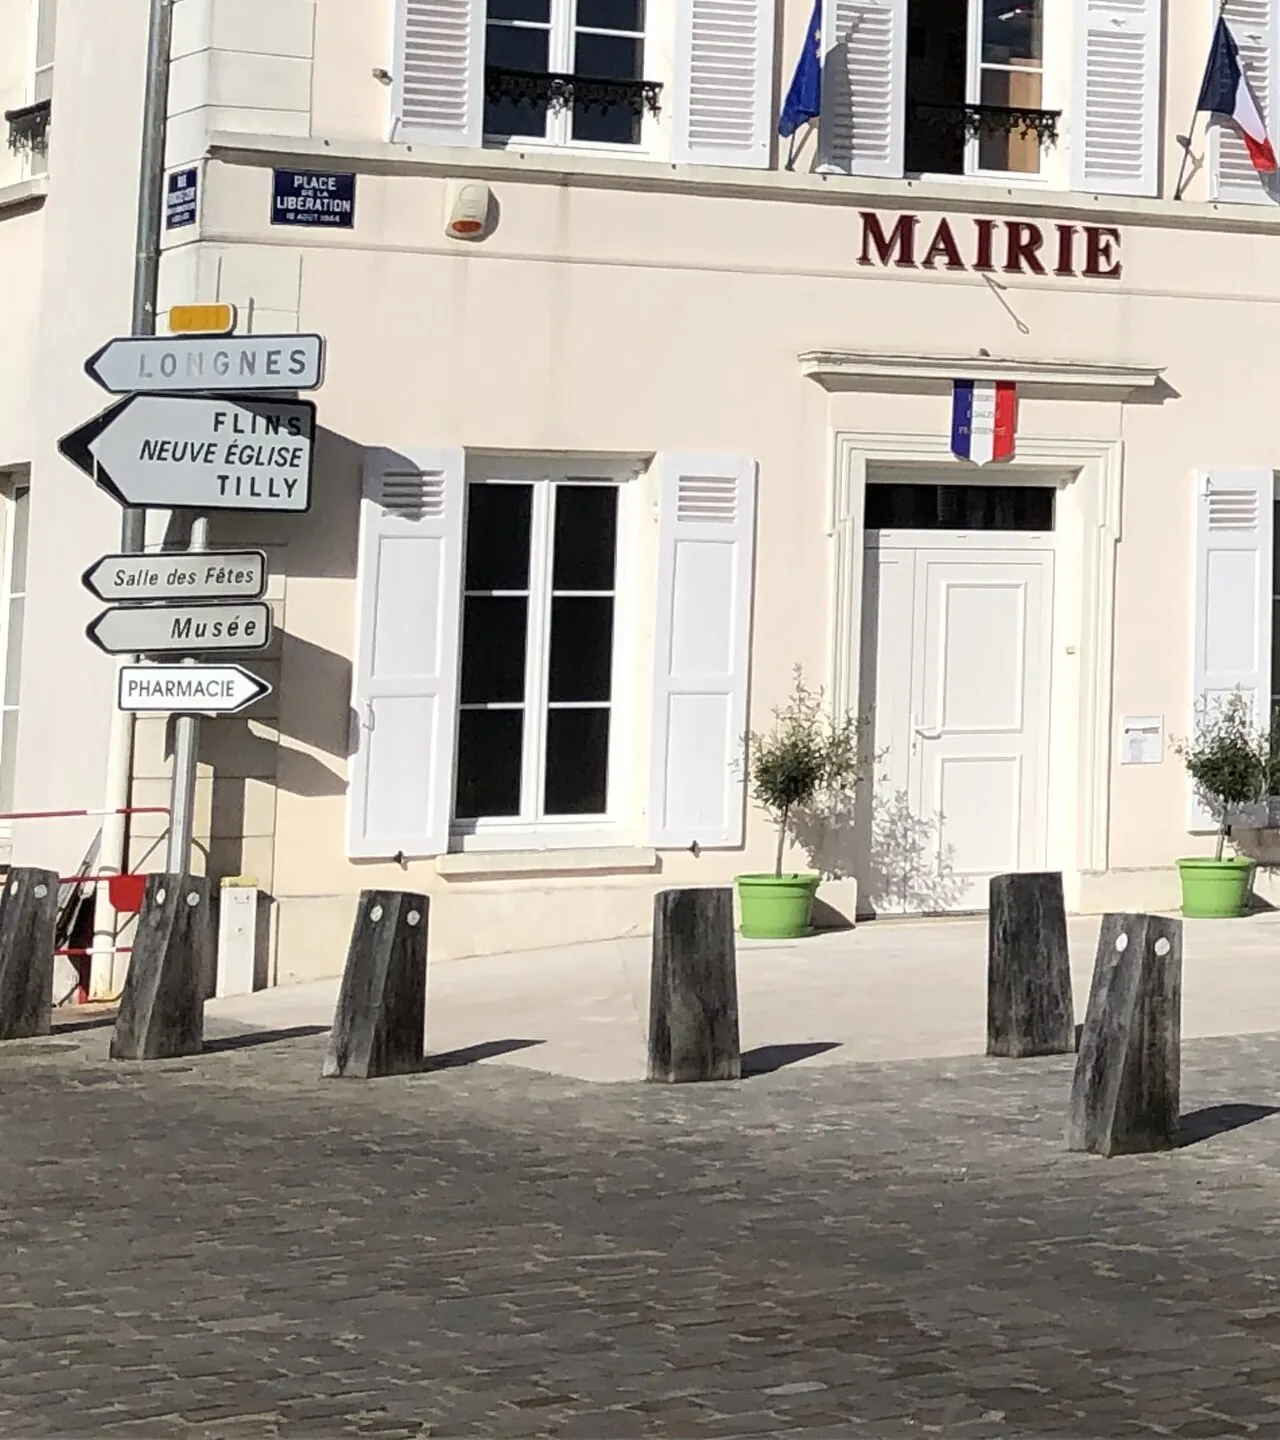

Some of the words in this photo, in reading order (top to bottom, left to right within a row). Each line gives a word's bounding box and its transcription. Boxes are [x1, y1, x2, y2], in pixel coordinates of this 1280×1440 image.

[293, 175, 337, 190] PLACE
[276, 195, 351, 213] LIBÉRATION
[856, 211, 1123, 279] MAIRIE
[138, 349, 307, 378] LONGNES
[213, 412, 301, 437] FLINS
[139, 439, 218, 464] NEUVE
[224, 438, 304, 468] ÉGLISE
[217, 474, 298, 498] TILLY
[114, 569, 159, 587] Salle
[166, 568, 197, 585] des
[204, 566, 254, 584] Fêtes
[170, 615, 257, 639] Musée
[128, 679, 235, 697] PHARMACIE
